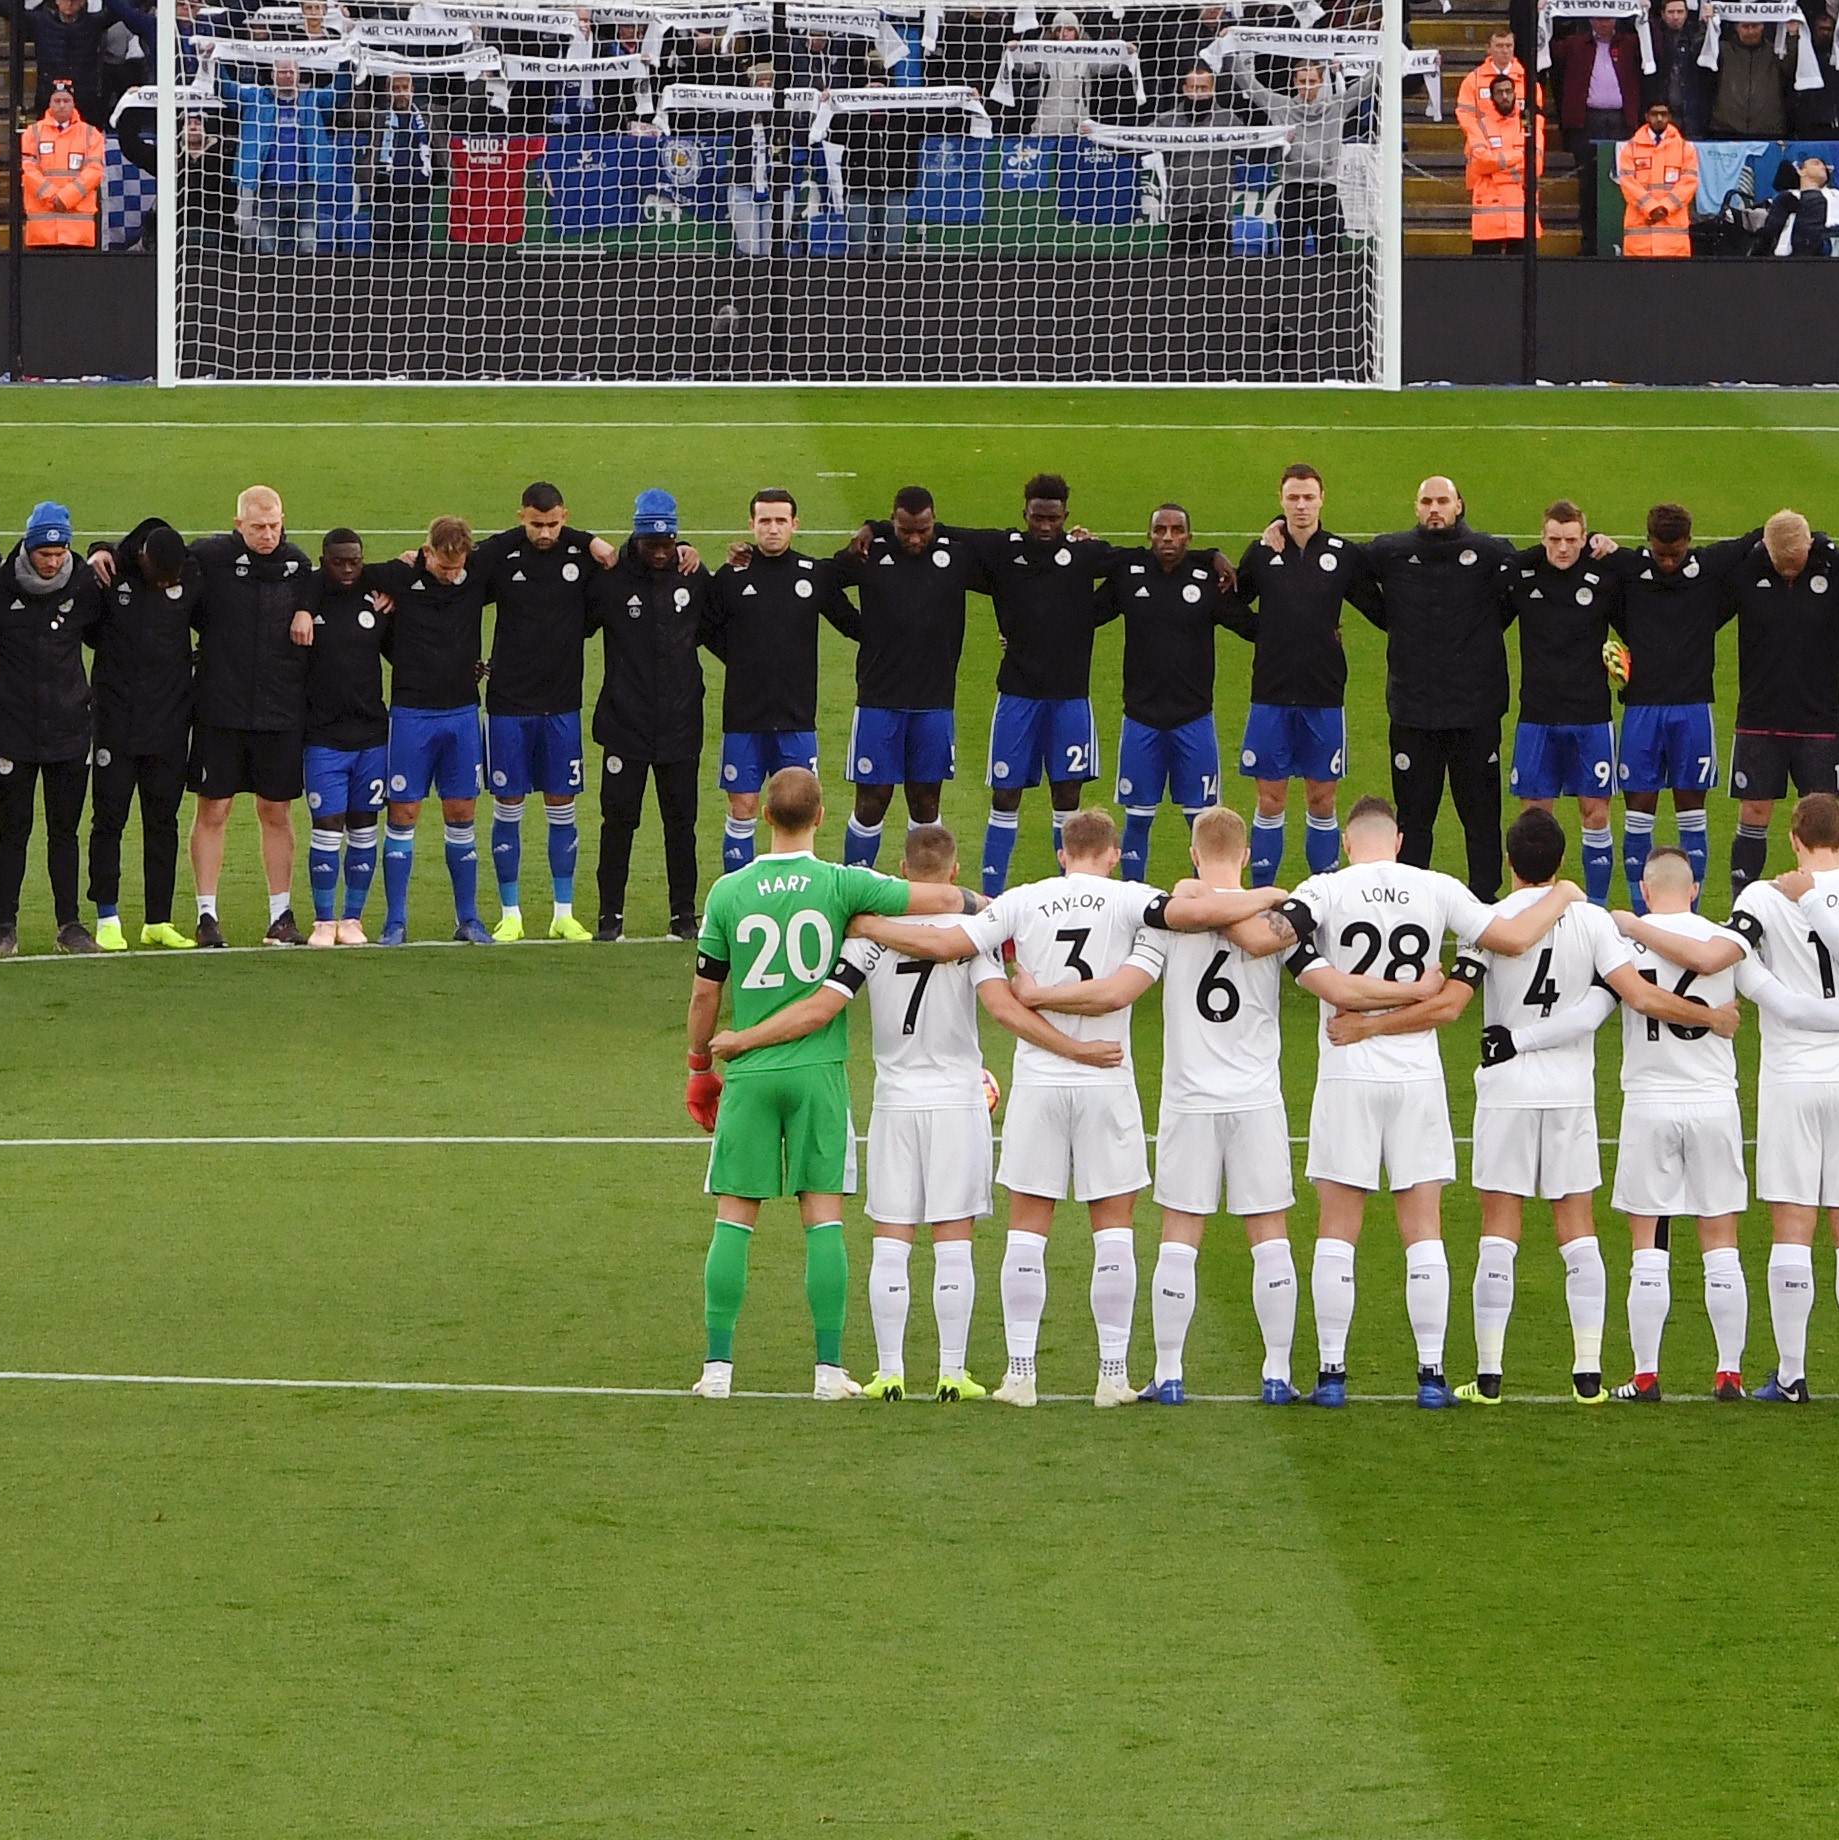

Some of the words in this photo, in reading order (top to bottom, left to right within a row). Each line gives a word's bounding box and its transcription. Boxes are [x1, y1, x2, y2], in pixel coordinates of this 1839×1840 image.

[1330, 748, 1341, 774] 6
[1594, 761, 1610, 788] 9
[1697, 756, 1711, 783] 7
[757, 875, 811, 896] HART
[1038, 893, 1106, 920] TAYLOR
[1361, 887, 1411, 905] LONG
[736, 909, 833, 989] 20
[1056, 928, 1093, 982] 3
[1339, 921, 1430, 983] 28
[896, 961, 932, 1035] 7
[1196, 950, 1240, 1023] 6
[1523, 948, 1560, 1017] 4
[1639, 968, 1710, 1040] 16
